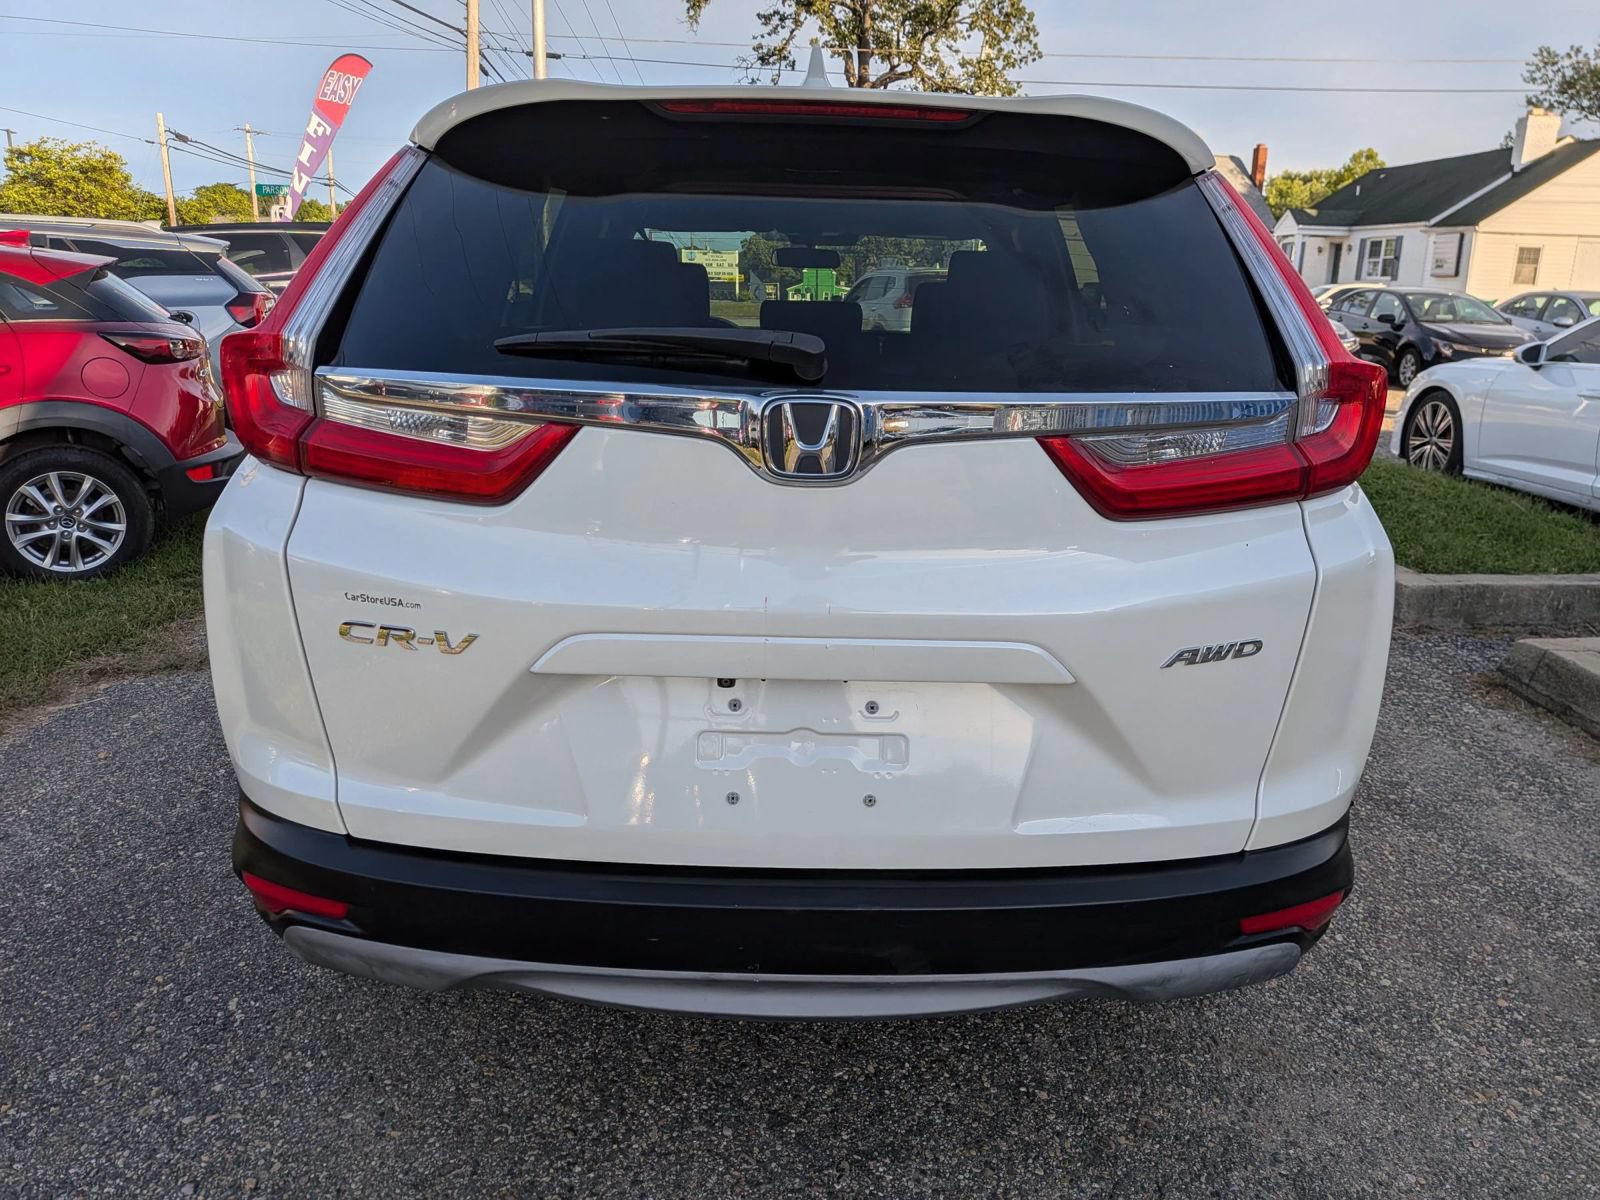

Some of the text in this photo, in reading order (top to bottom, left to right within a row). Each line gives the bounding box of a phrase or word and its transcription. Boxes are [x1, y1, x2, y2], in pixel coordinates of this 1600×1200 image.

[319, 70, 363, 105] EASY
[344, 592, 421, 609] CarStoreUSA.com
[338, 619, 480, 655] CR-V
[1160, 638, 1263, 669] AWD
